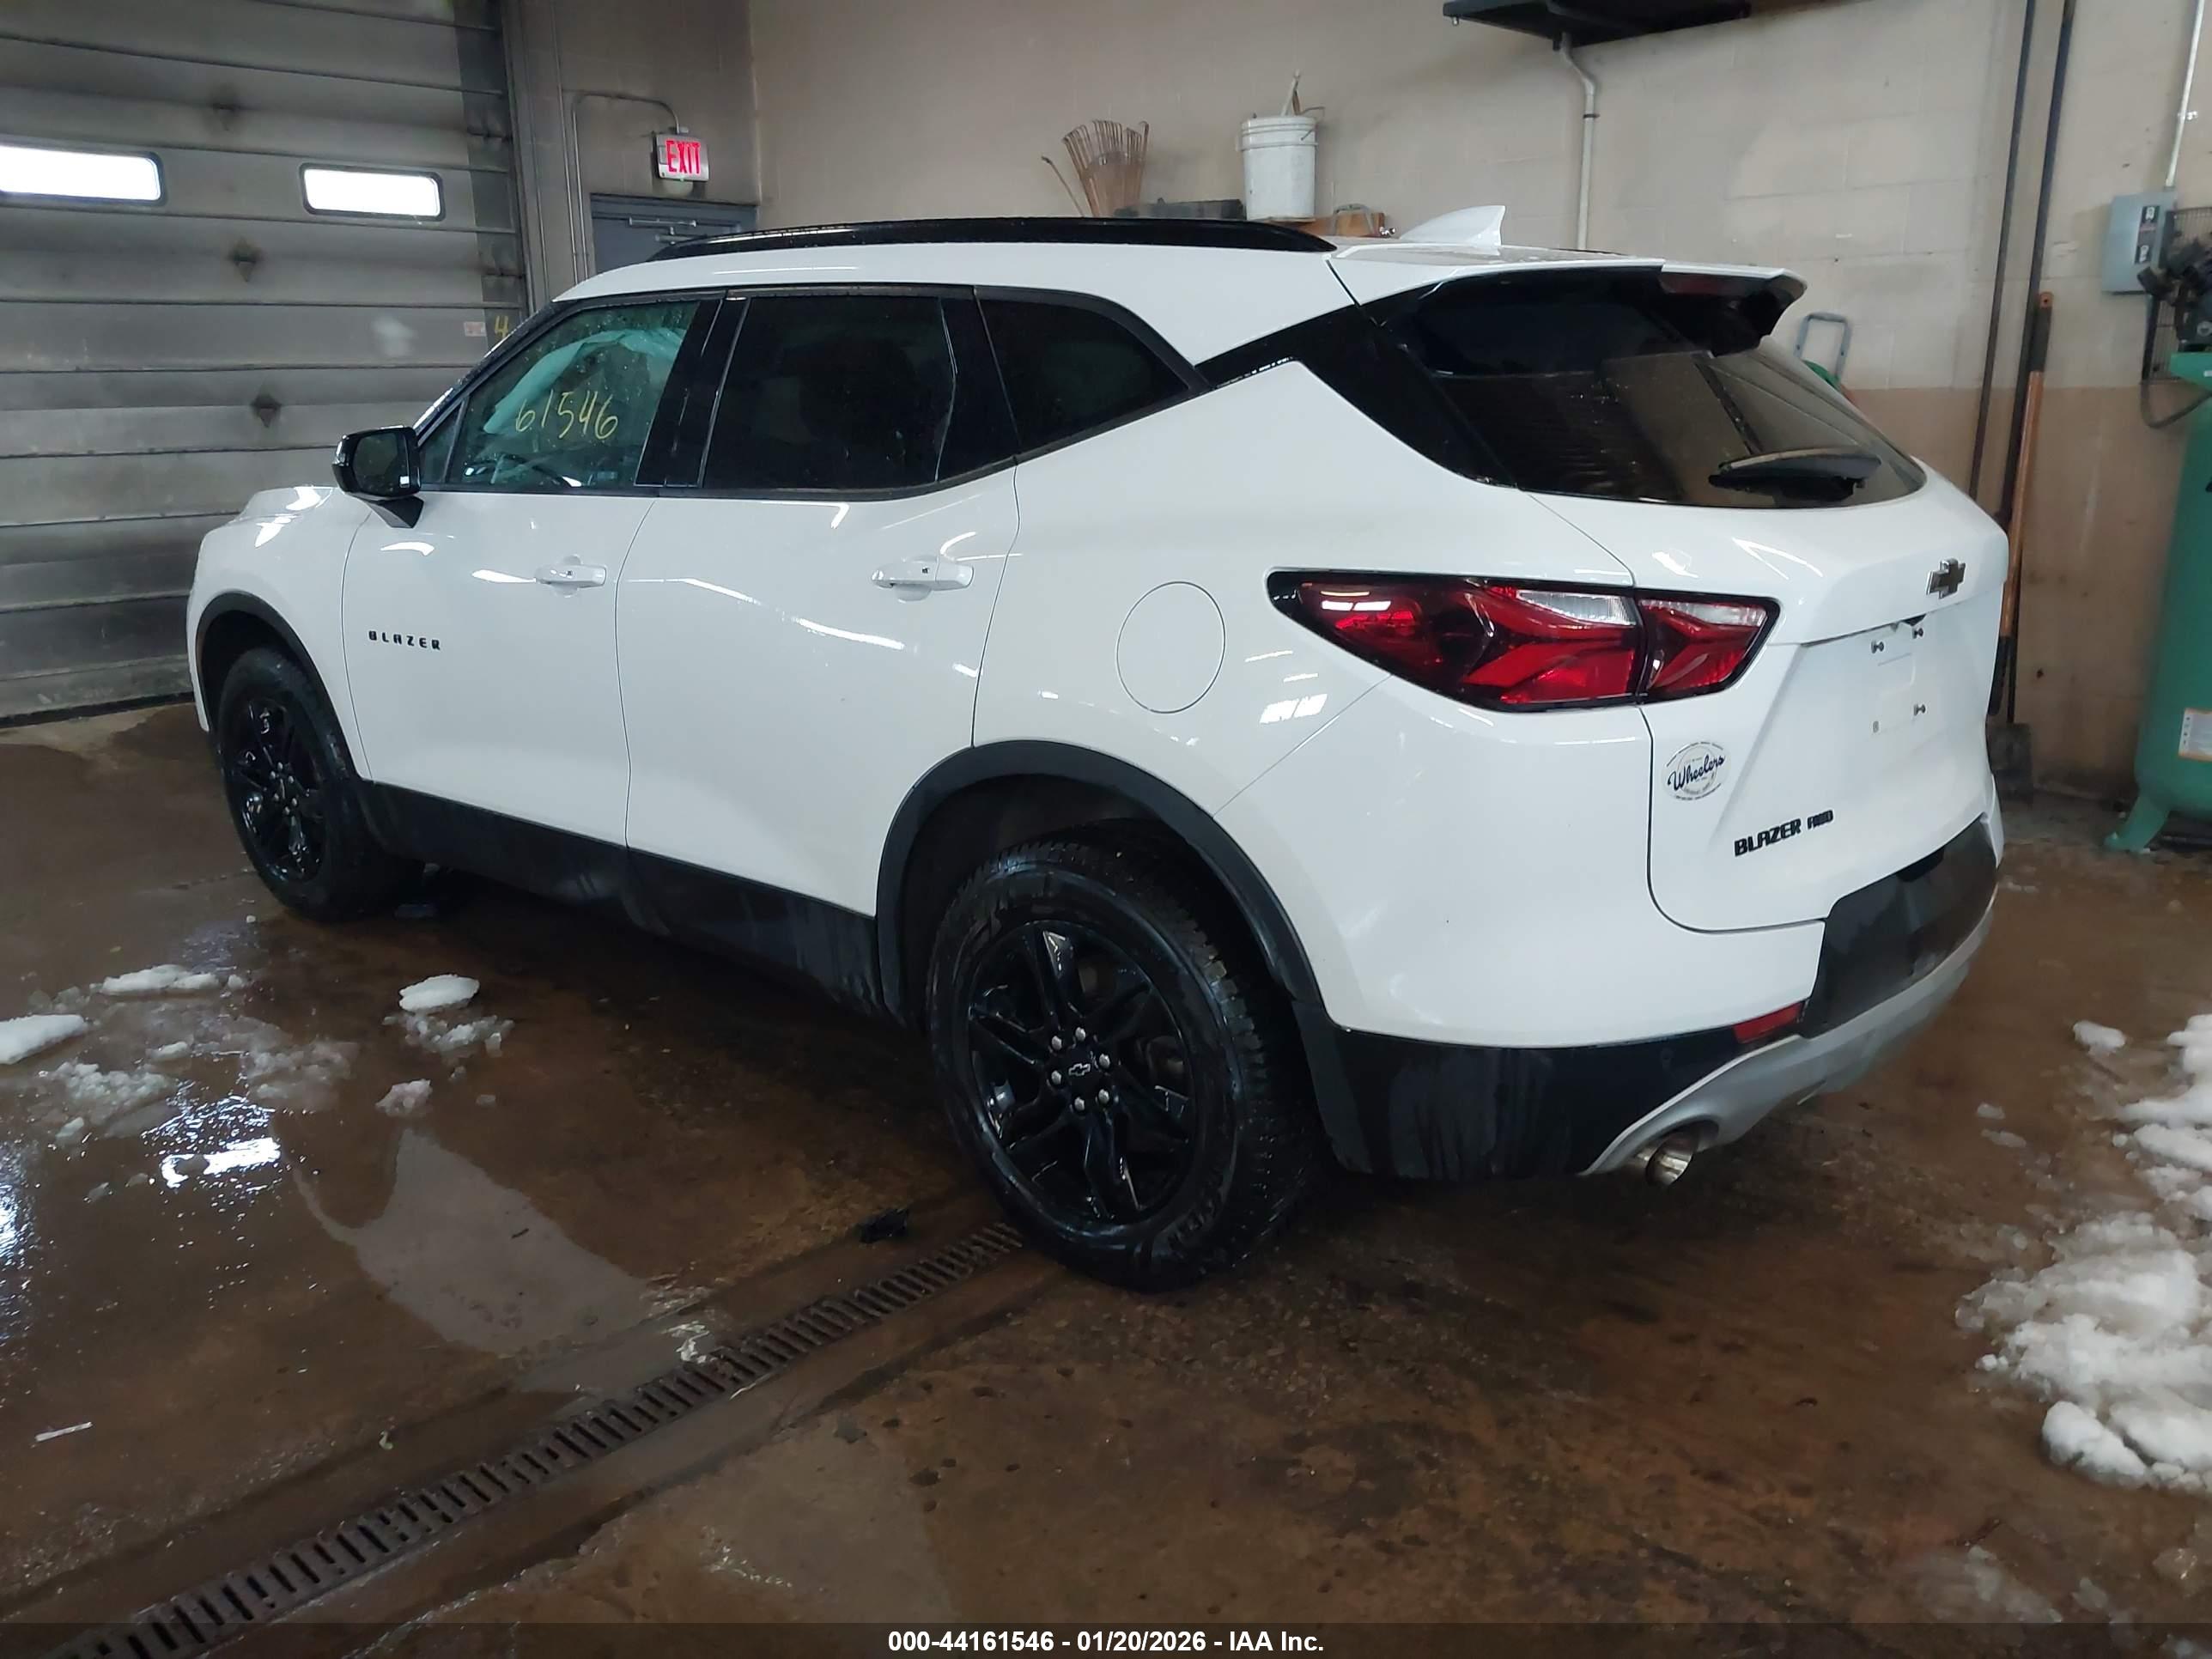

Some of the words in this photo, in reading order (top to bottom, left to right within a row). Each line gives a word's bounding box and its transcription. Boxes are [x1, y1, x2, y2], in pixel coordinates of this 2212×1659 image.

[665, 140, 701, 174] EXIT
[494, 315, 509, 340] 4
[515, 388, 618, 440] 61546
[368, 630, 441, 651] BLAZER
[1667, 753, 1726, 792] Wheelers
[1734, 817, 1802, 857] BLAZER
